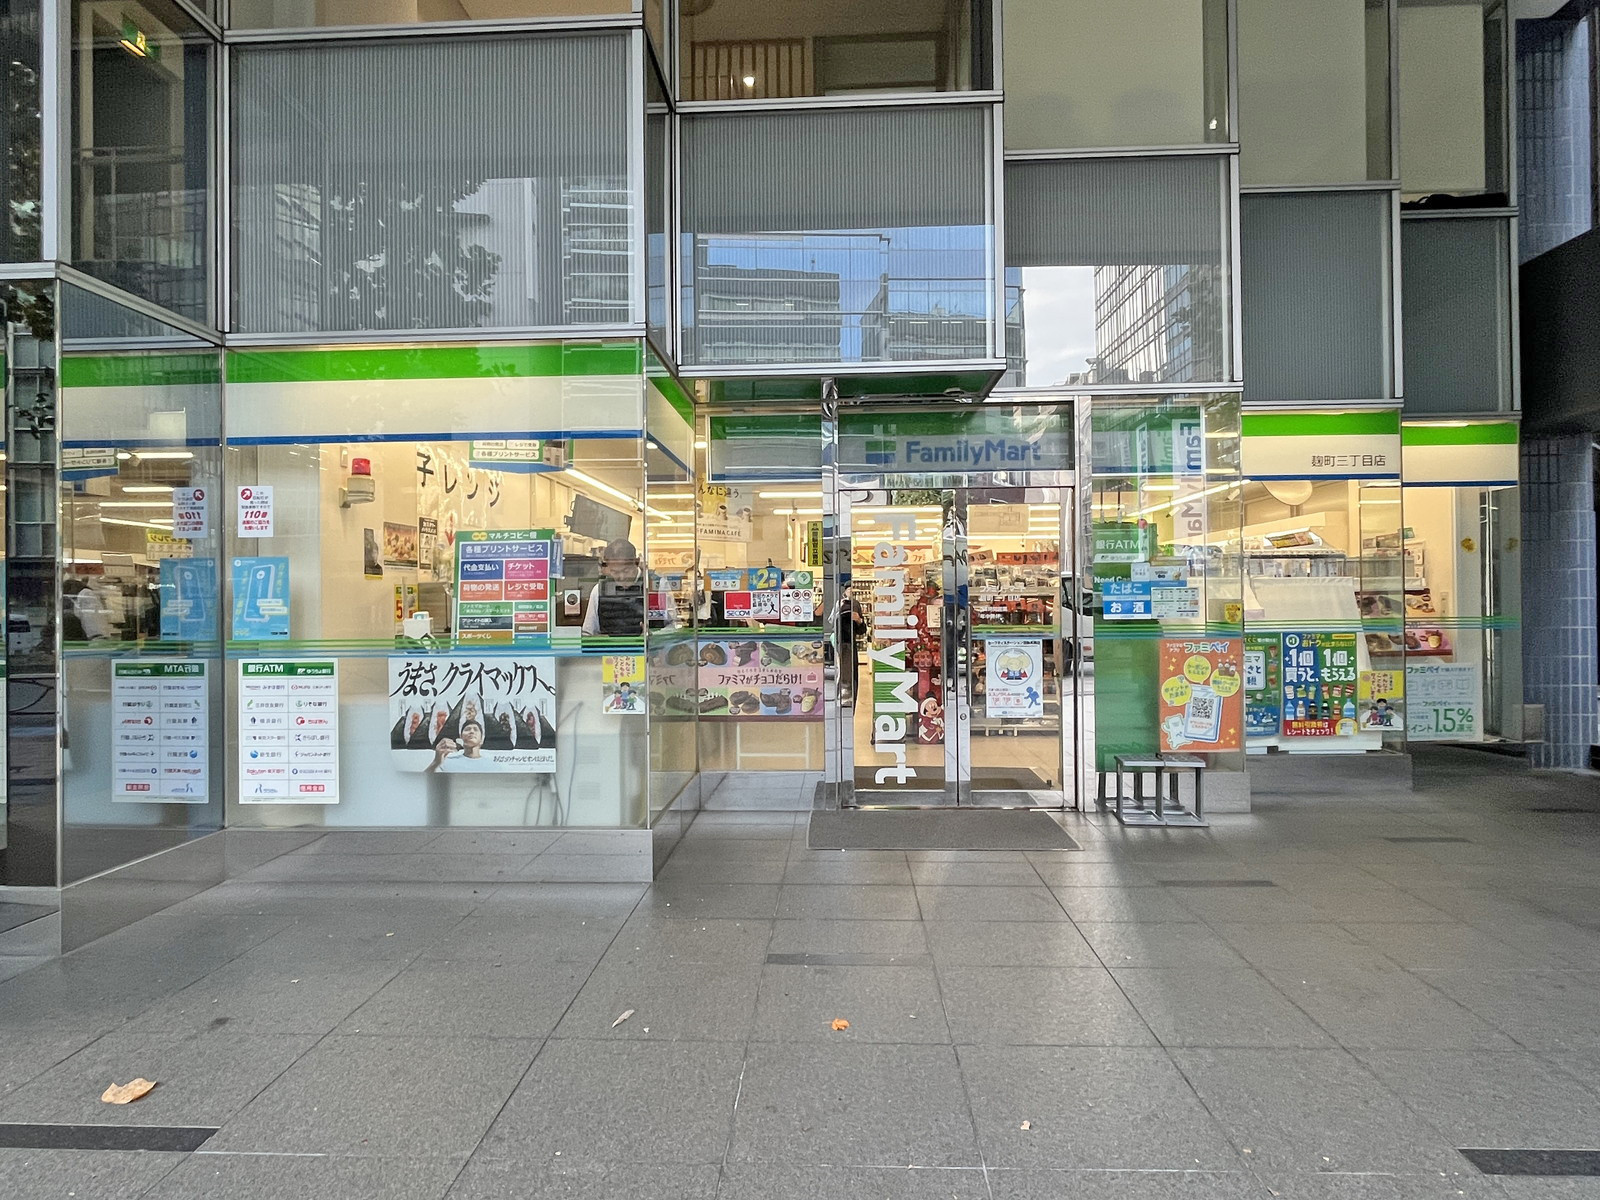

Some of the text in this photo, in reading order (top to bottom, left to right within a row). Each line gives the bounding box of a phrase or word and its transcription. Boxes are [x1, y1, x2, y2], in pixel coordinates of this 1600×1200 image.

[906, 440, 1041, 465] FamilyMart
[489, 531, 537, 539] マルチコピー機
[466, 544, 543, 553] 各種プリントサービス
[463, 563, 499, 571] 代金支払い
[508, 562, 534, 570] チケット
[1110, 583, 1143, 594] たばこ
[867, 513, 918, 784] FamilyMart
[1183, 641, 1230, 653] ファミペイ
[1289, 648, 1348, 667] 1個 1個
[247, 664, 284, 673] 銀行ATM
[1406, 666, 1440, 674] ファミペイ
[389, 661, 556, 697] うまさ、クライマックス。
[718, 673, 802, 685] ファミマがチョコだらけ!
[1321, 667, 1355, 682] もらえる
